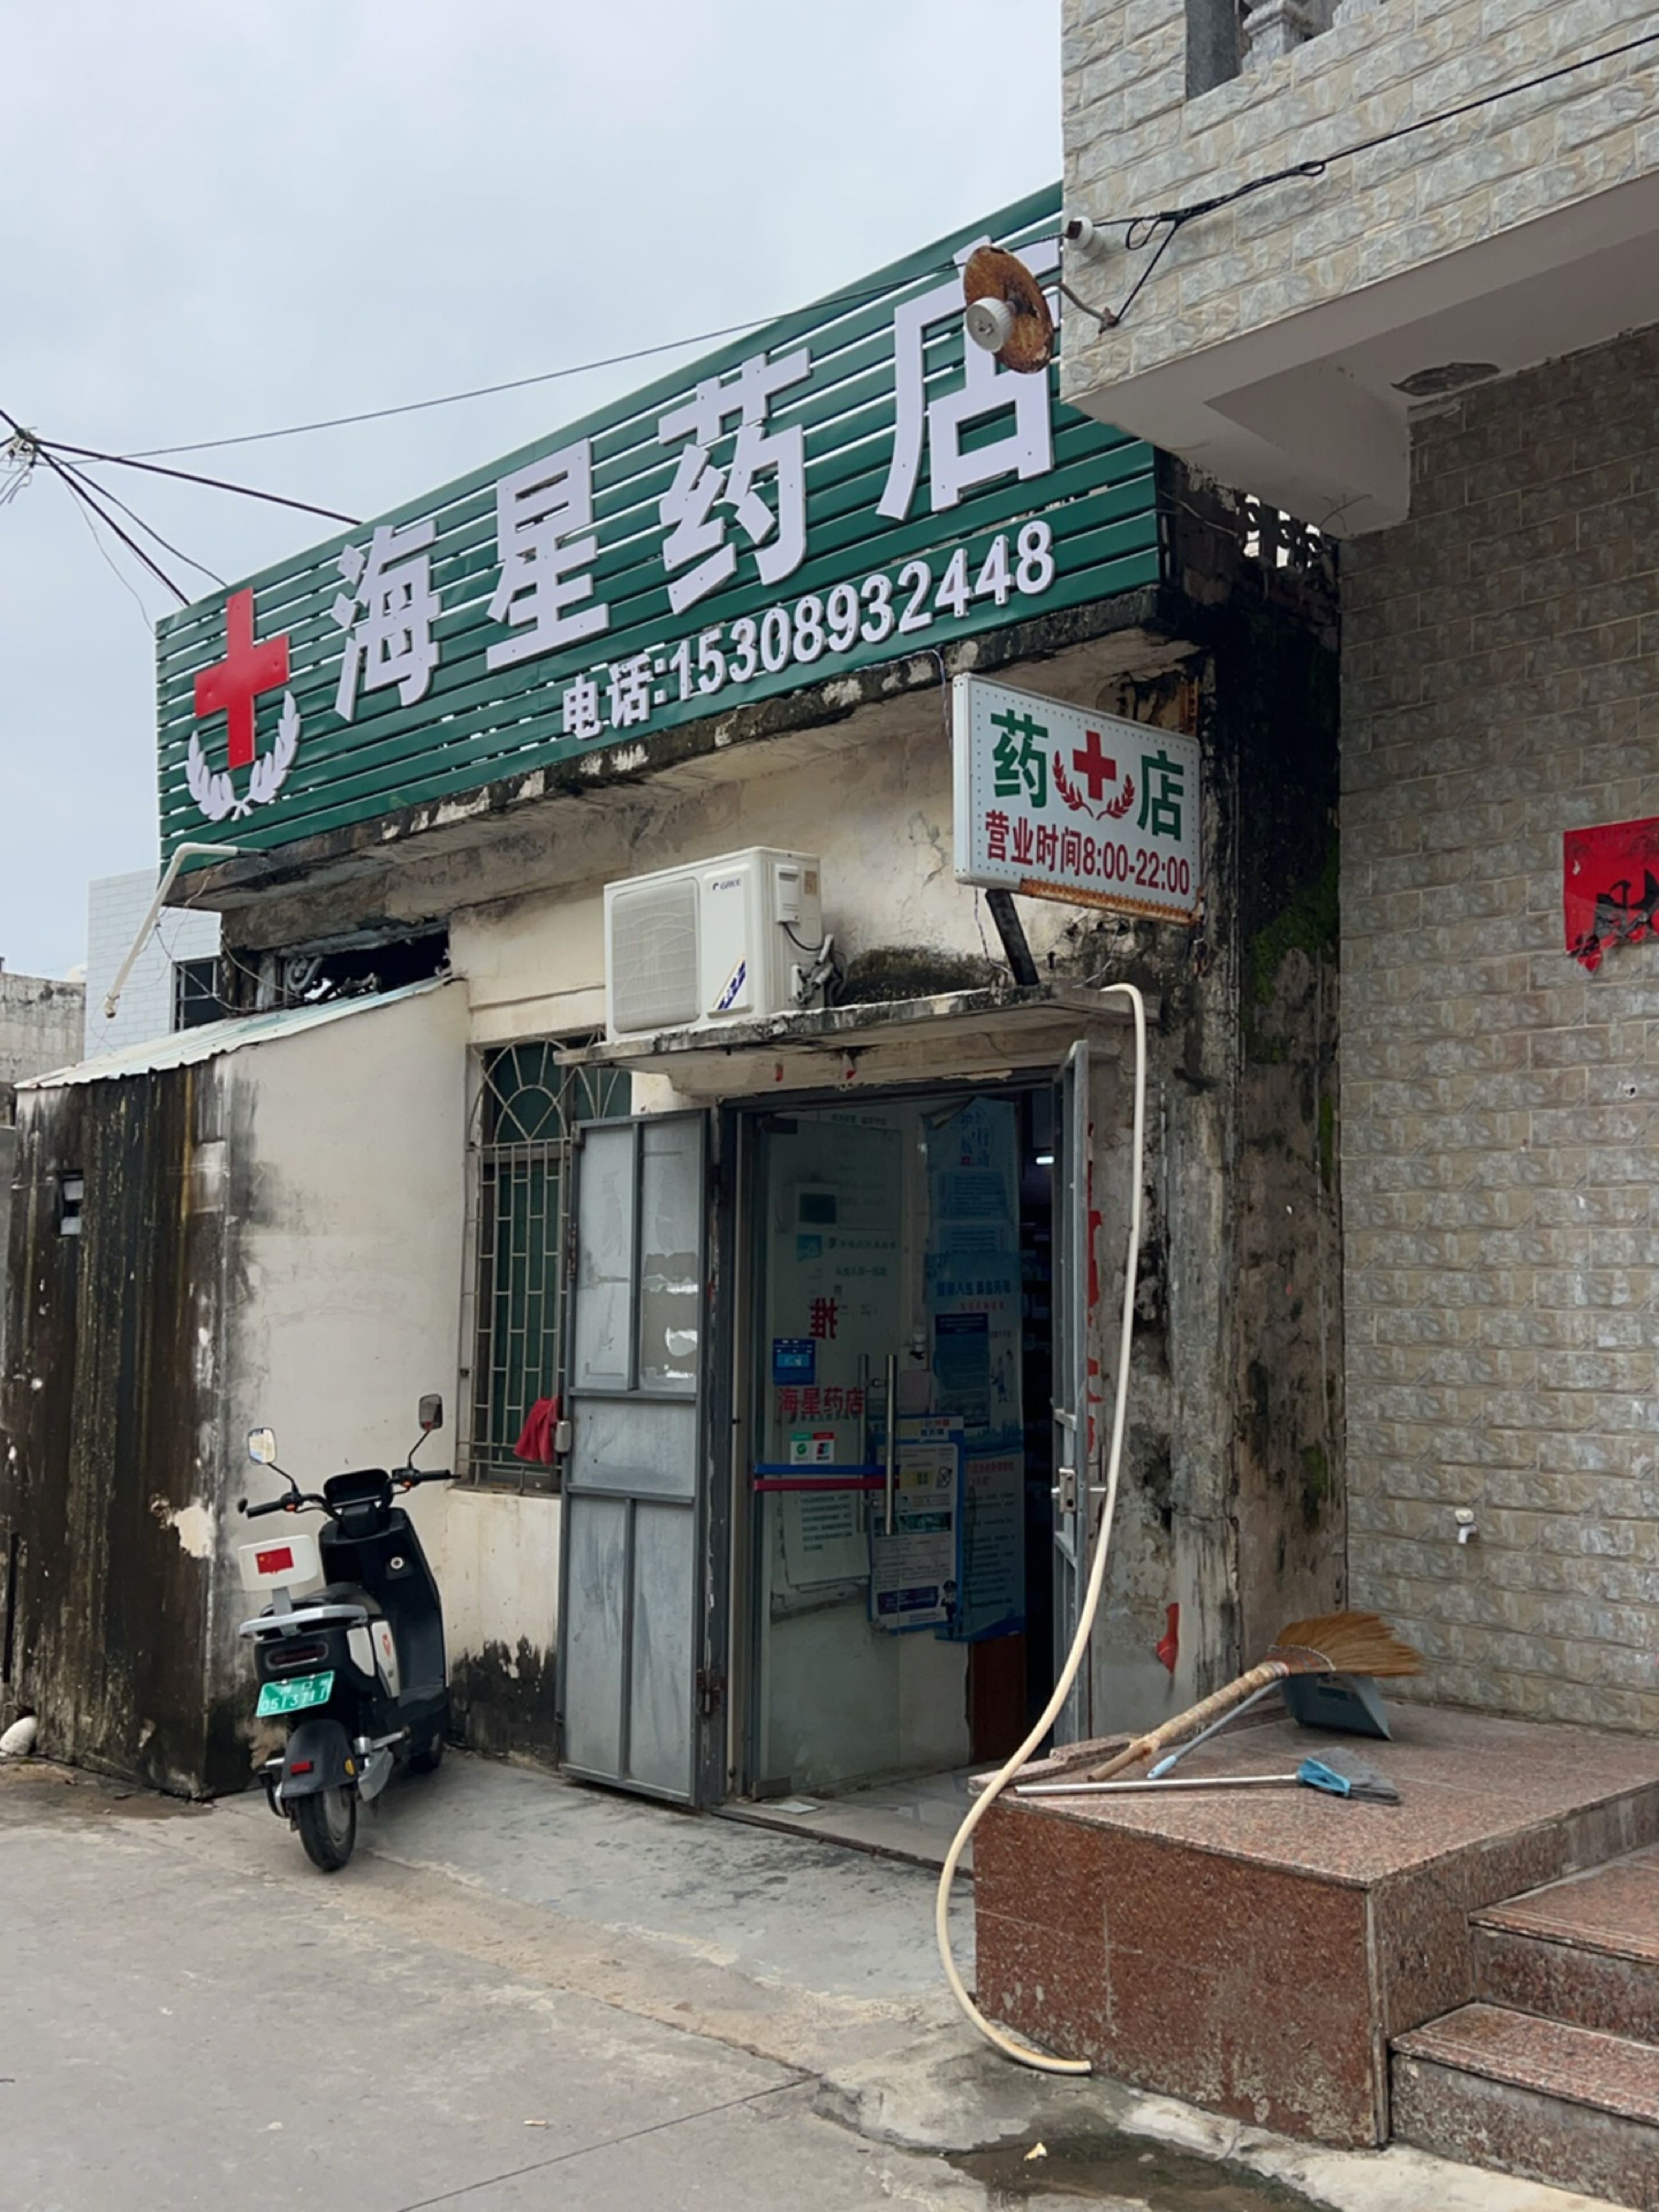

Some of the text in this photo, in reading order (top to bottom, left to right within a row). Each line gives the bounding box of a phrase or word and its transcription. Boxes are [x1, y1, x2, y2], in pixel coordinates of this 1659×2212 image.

[330, 235, 1060, 722] 海星药店
[562, 520, 1054, 739] 电话:15308932448
[984, 810, 1190, 895] 营业时间8:00-22:00
[777, 1386, 865, 1416] 海星药店
